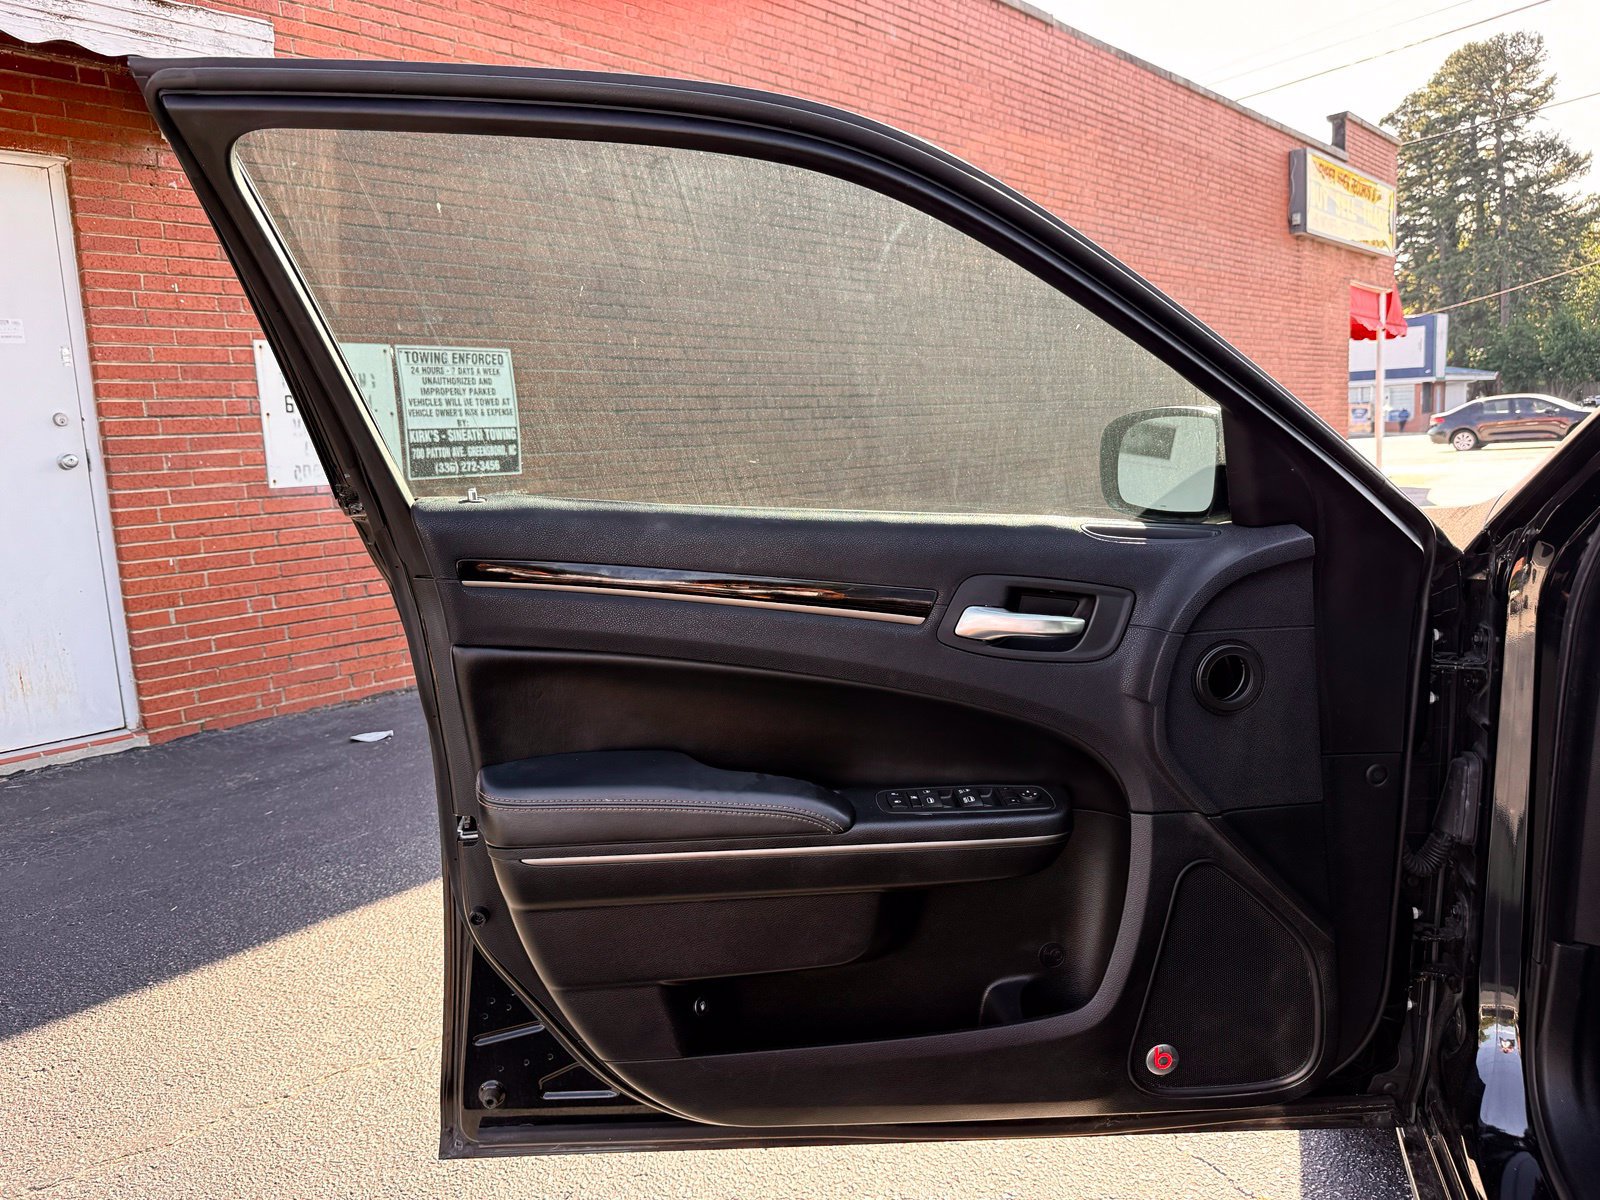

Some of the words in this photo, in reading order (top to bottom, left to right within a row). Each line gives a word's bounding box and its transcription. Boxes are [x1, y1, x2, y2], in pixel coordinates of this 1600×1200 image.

[404, 351, 448, 364] TOWING
[452, 353, 504, 365] ENFORCED
[422, 377, 476, 385] UNAUTHORIZED
[408, 398, 444, 407] VEHICLES
[476, 398, 499, 406] TOWED
[435, 409, 463, 417] OWNER'S
[410, 430, 440, 443] KIRK'S
[447, 429, 483, 442] SINEATH
[485, 428, 516, 441] TOWING
[426, 446, 450, 458] PATTON
[435, 461, 459, 474] (336)
